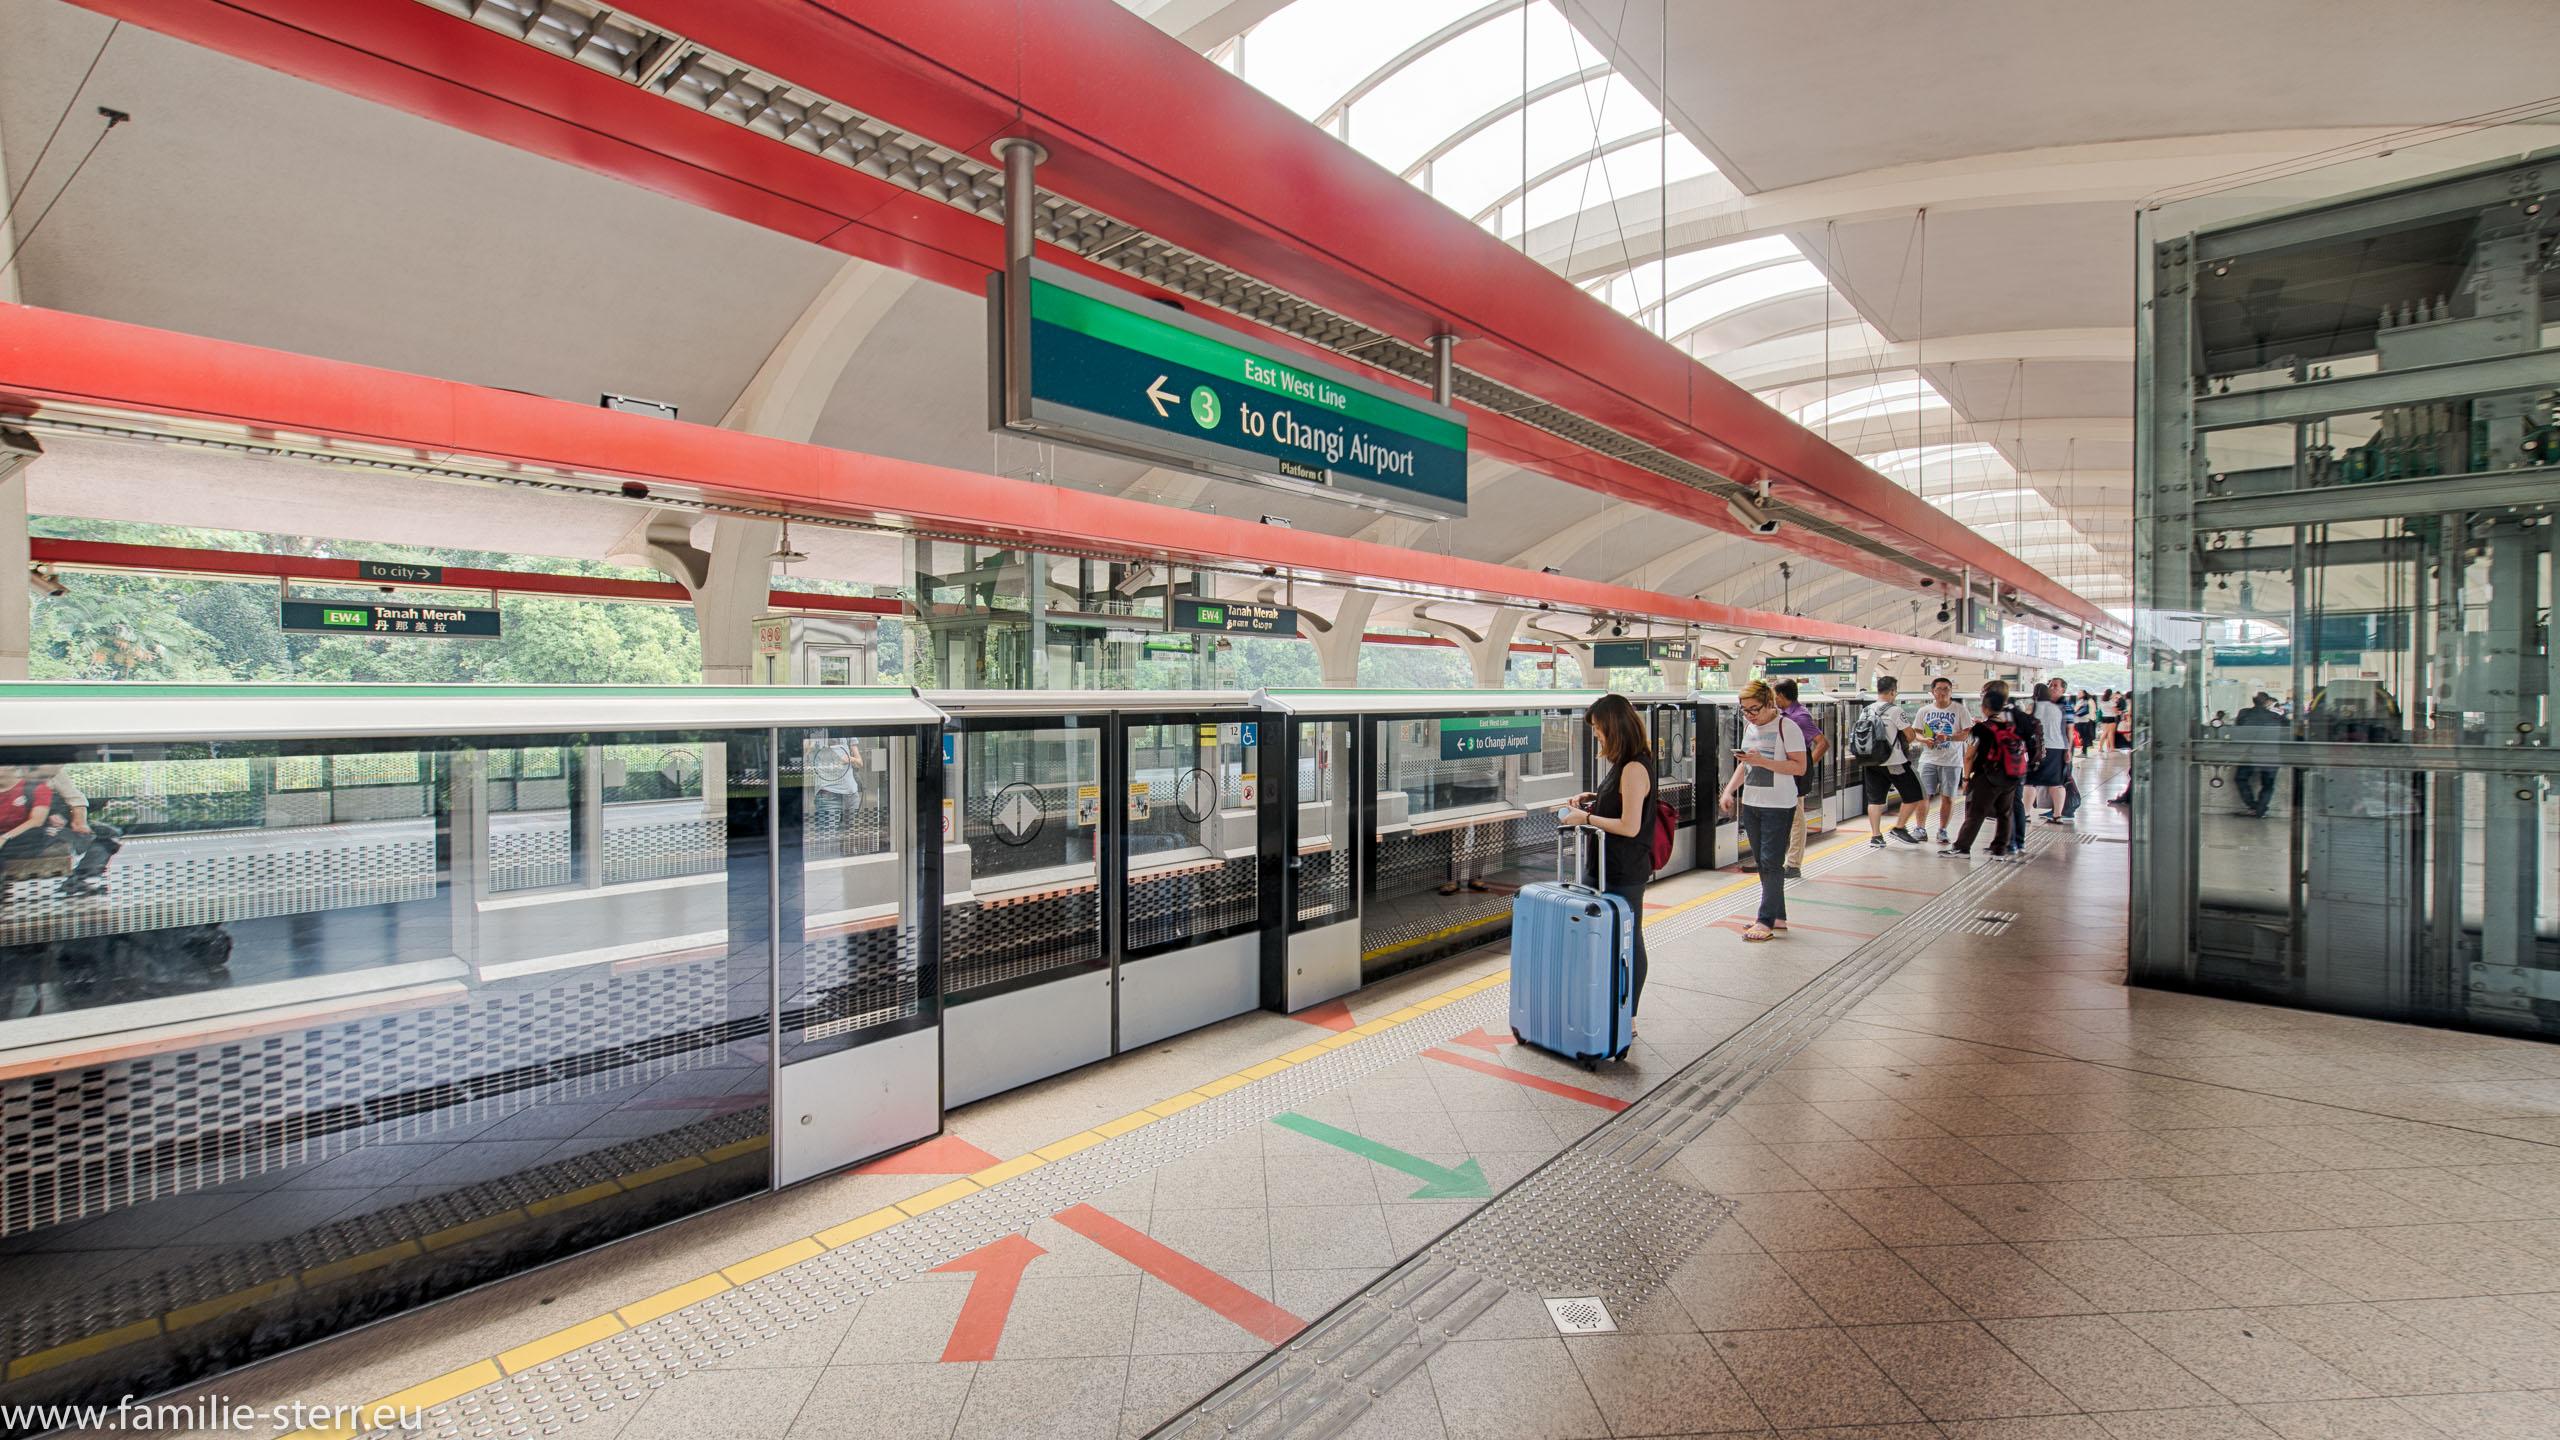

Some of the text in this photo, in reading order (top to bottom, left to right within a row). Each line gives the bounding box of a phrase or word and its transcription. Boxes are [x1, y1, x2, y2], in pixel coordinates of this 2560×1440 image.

[1244, 358, 1347, 409] East West Line
[1199, 391, 1414, 477] 3 to Changi Airport
[1281, 462, 1323, 482] Platform C
[372, 565, 415, 580] to city
[330, 612, 361, 623] EW4
[374, 607, 466, 621] Tanah Merah
[1201, 609, 1219, 621] EW4
[1227, 605, 1279, 619] Tanah Merah
[375, 620, 447, 633] 丹那美拉
[1926, 711, 1956, 725] ADIDAS
[1230, 726, 1238, 736] 12
[1469, 734, 1528, 749] 3 to Changi Airport
